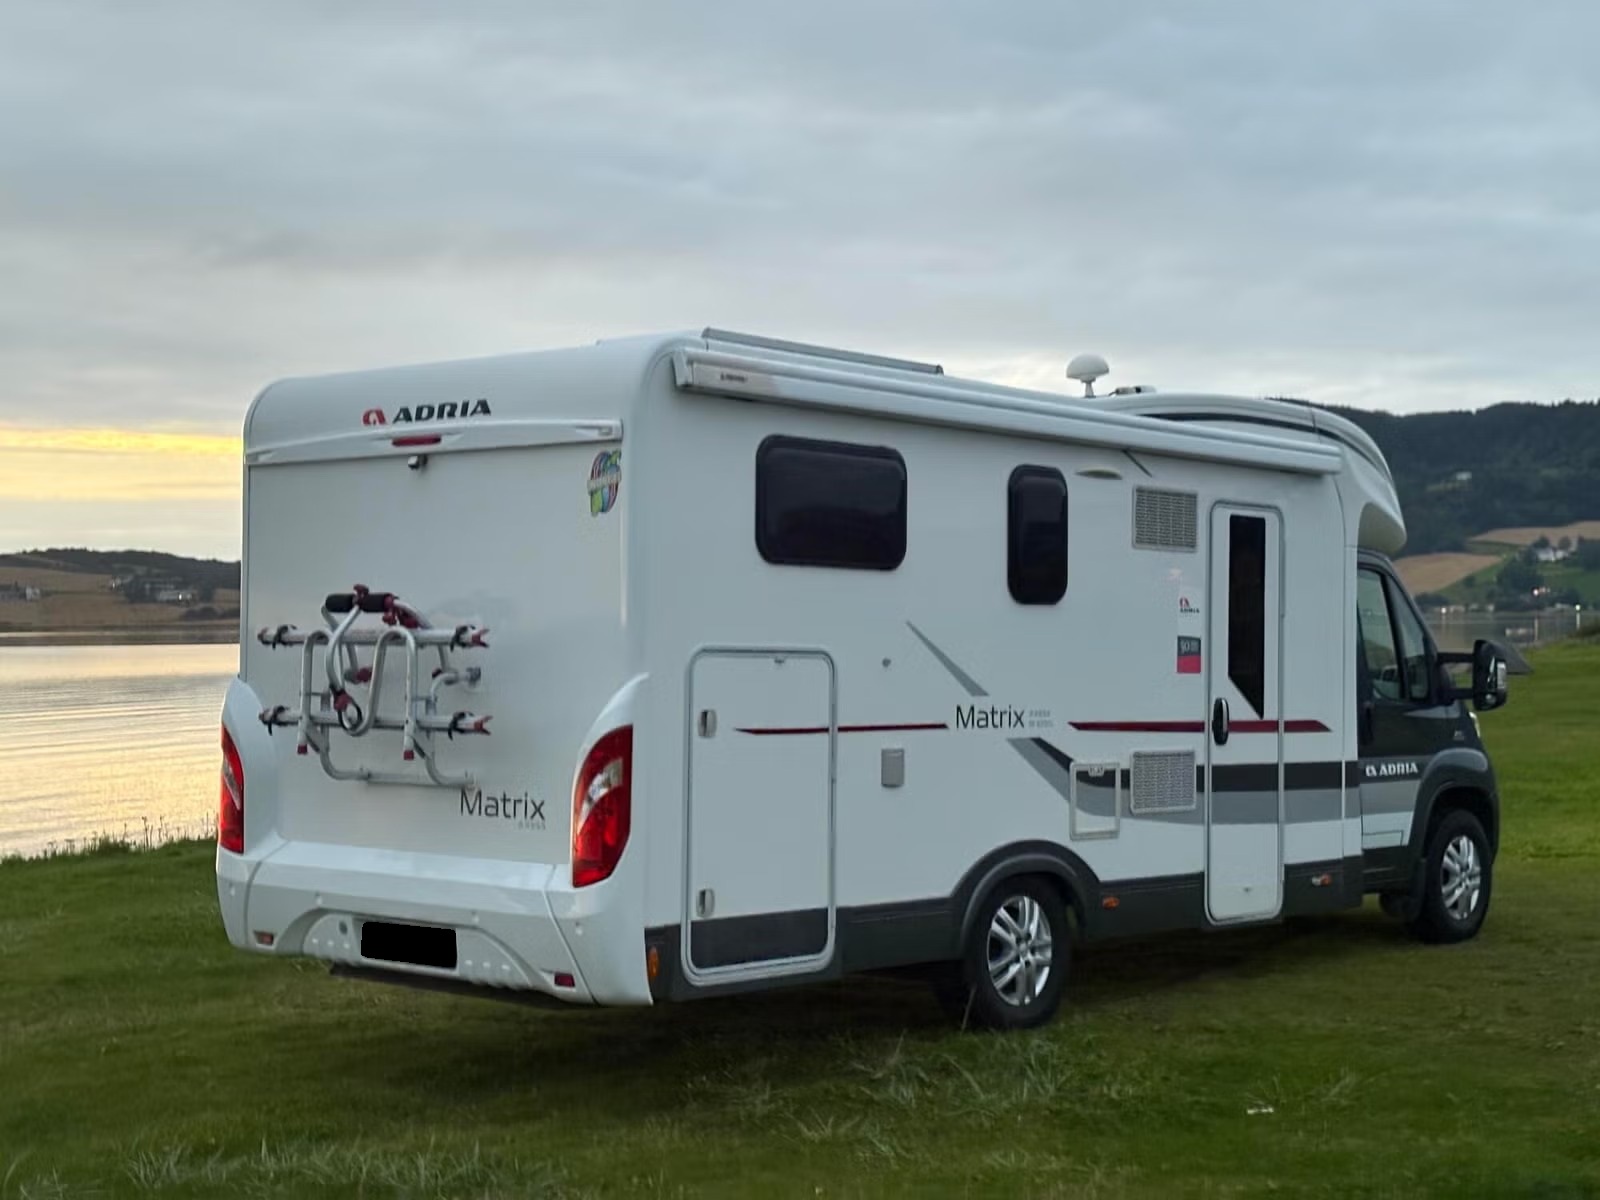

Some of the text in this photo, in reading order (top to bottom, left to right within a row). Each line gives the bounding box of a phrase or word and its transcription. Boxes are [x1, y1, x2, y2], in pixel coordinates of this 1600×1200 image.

[392, 399, 491, 424] ADRIA
[956, 704, 1025, 729] Matrix
[1379, 762, 1418, 776] ADRIA
[460, 787, 545, 820] Matrix
